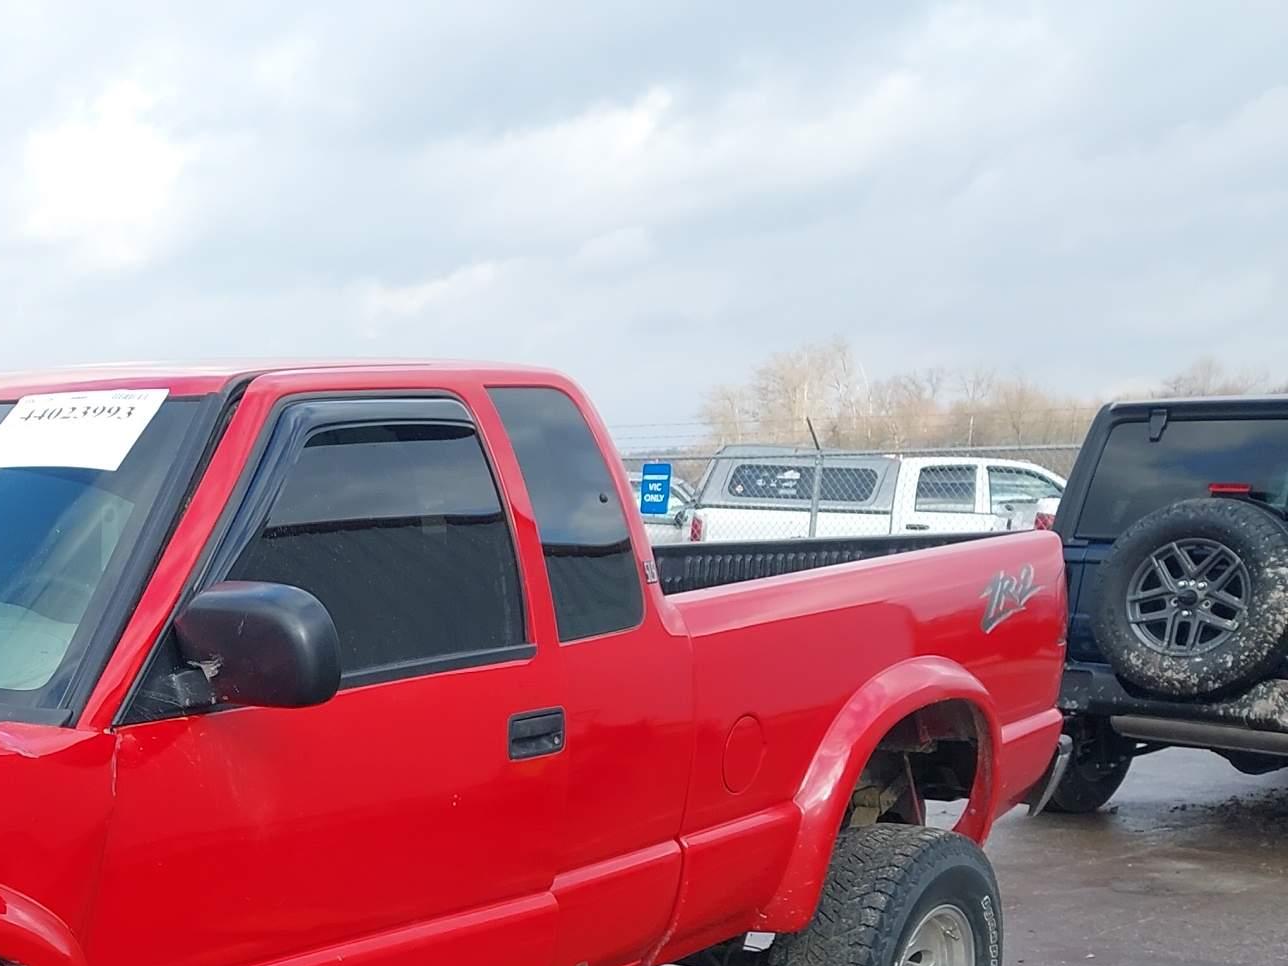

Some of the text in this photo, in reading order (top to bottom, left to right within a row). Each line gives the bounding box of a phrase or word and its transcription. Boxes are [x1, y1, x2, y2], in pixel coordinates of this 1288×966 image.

[20, 405, 136, 421] 44023993
[649, 482, 663, 492] VIC
[643, 493, 665, 503] ONLY
[977, 562, 1047, 635] ZR2
